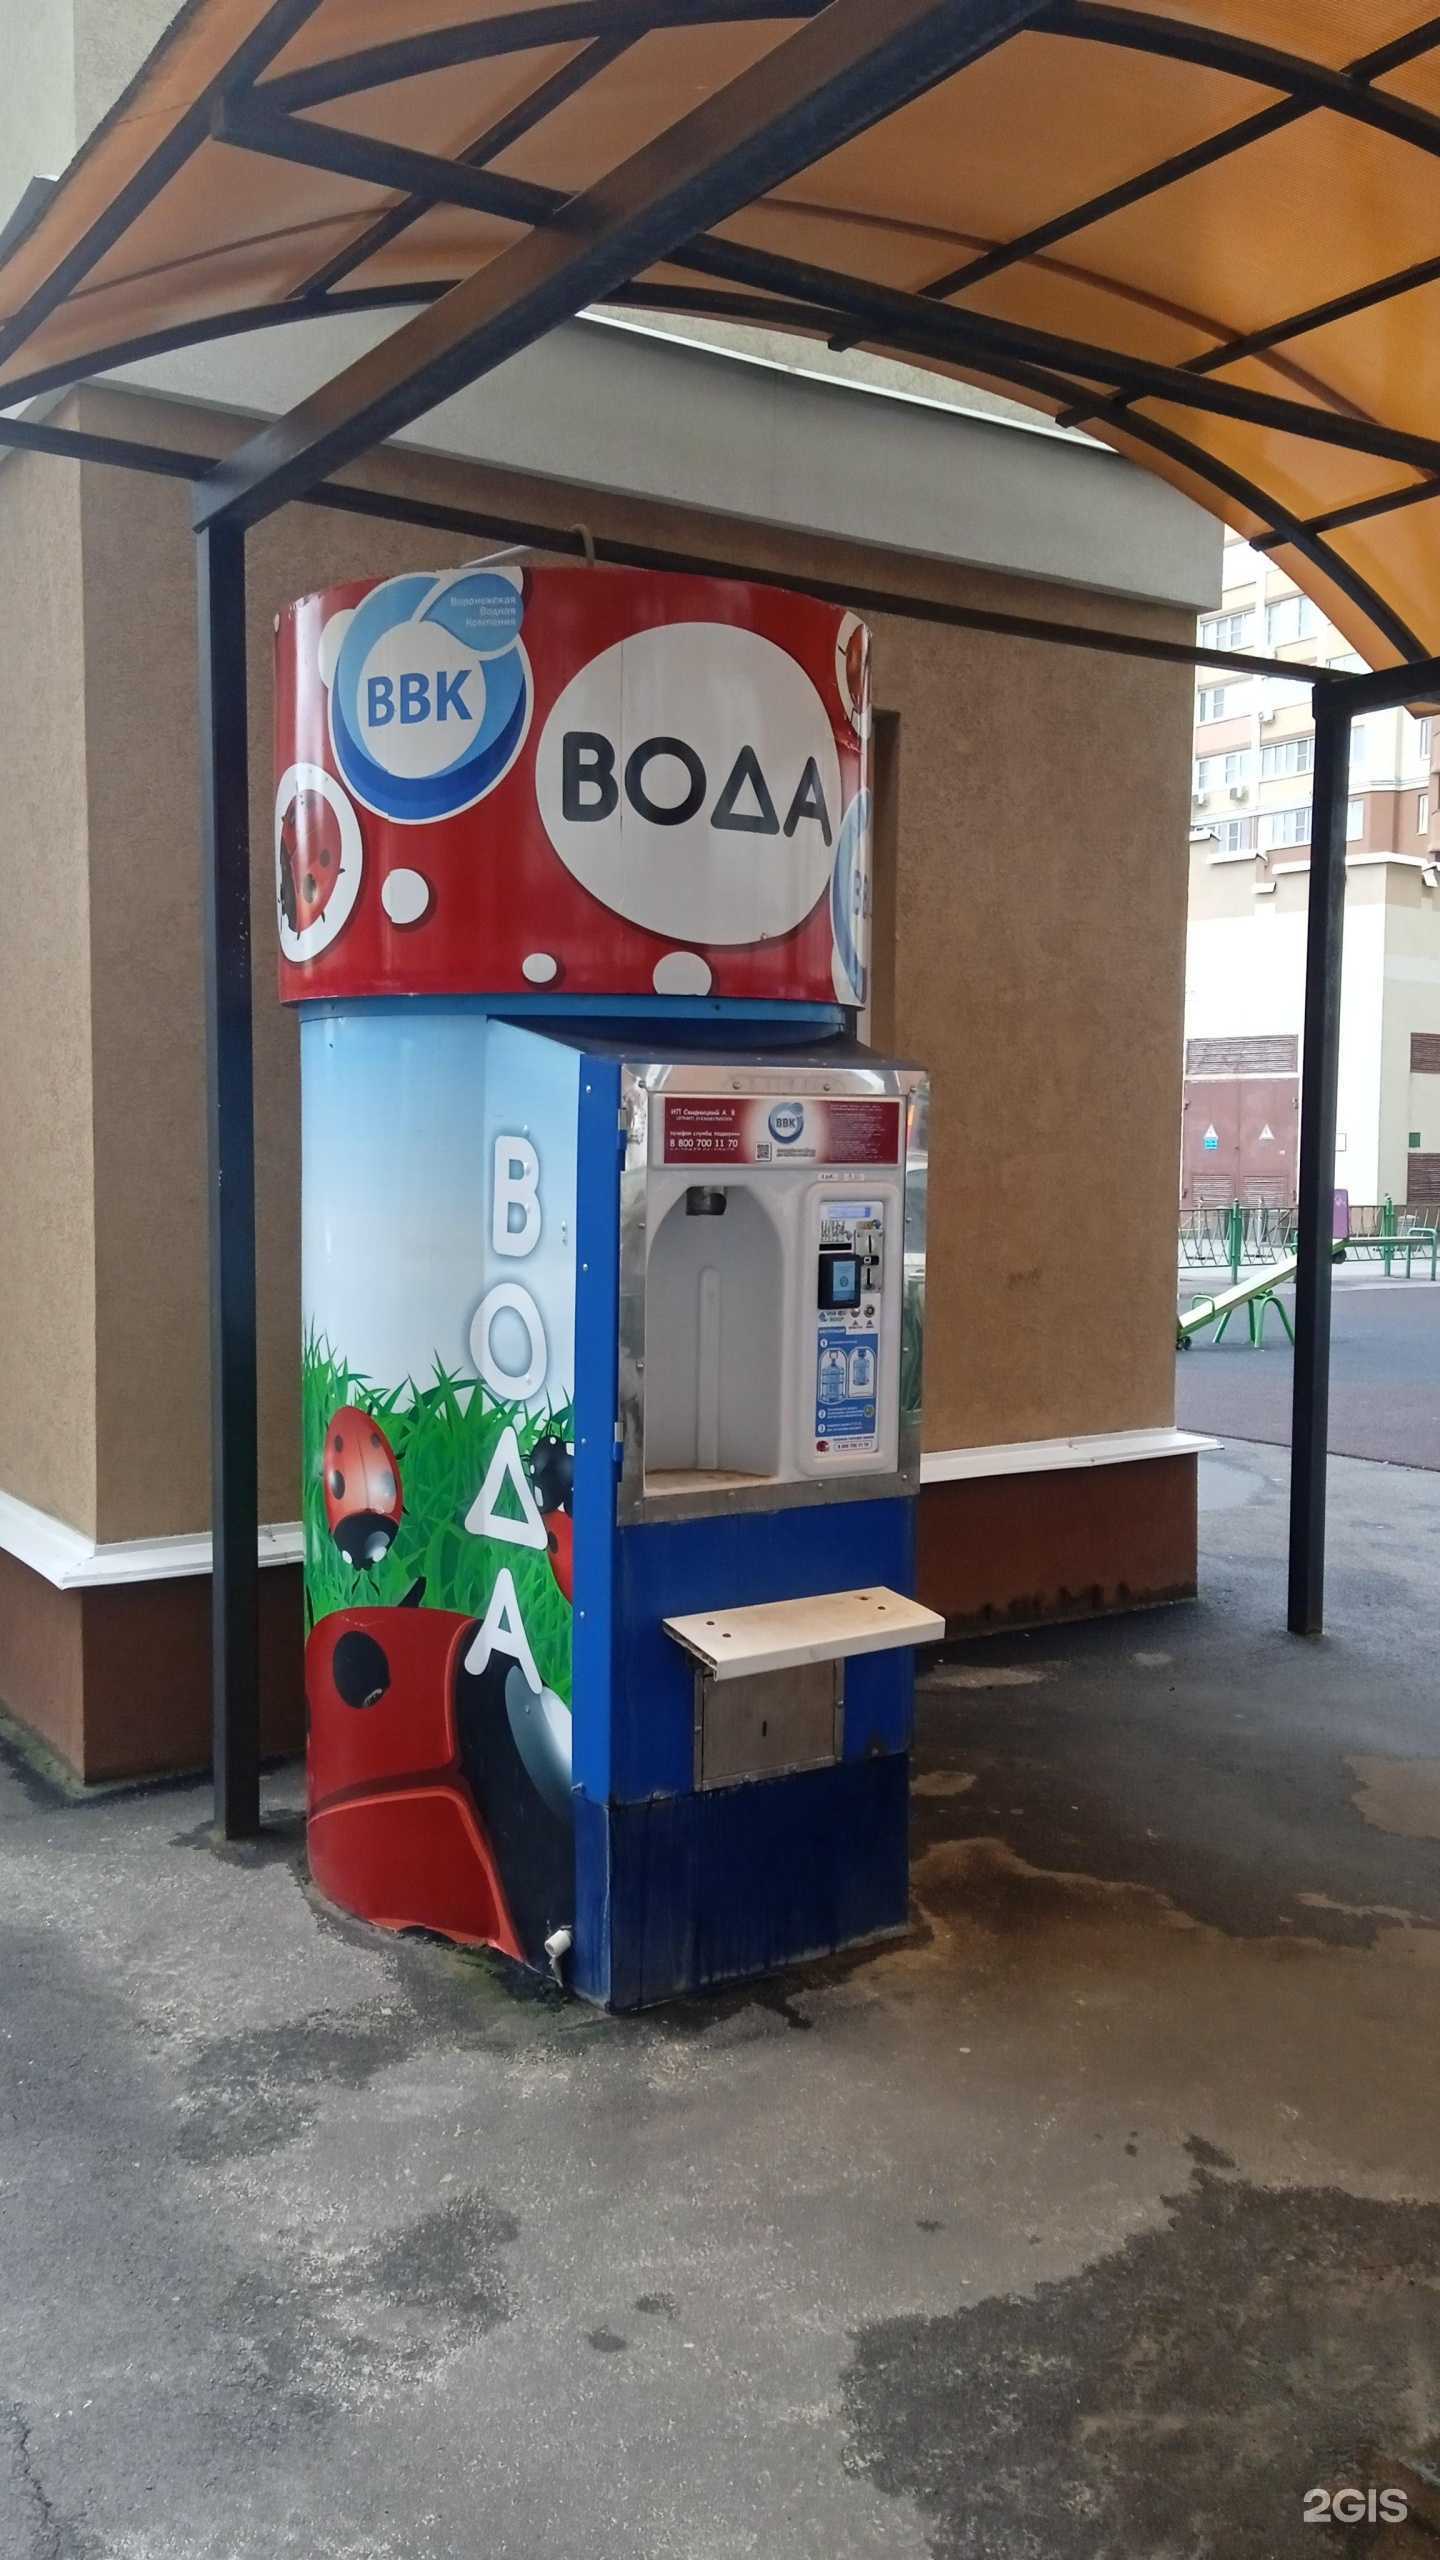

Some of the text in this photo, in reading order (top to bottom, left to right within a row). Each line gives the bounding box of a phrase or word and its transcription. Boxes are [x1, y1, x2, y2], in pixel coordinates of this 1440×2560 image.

[368, 669, 473, 728] ВВК
[562, 731, 833, 848] ВОДА
[670, 1138, 739, 1148] 8 800 700 11 70
[776, 1118, 796, 1129] ВВК
[464, 1135, 549, 1696] ВОДА
